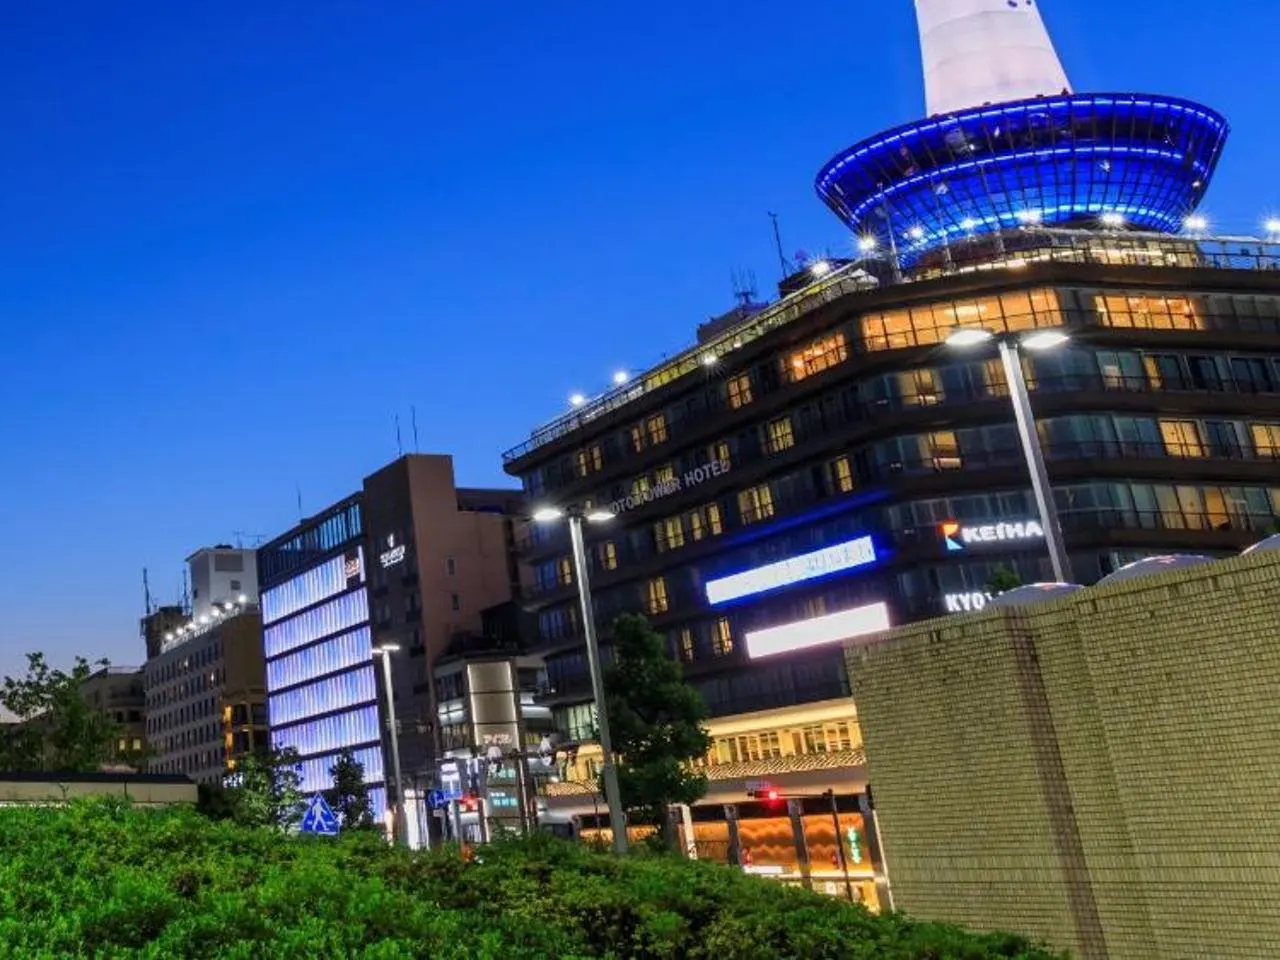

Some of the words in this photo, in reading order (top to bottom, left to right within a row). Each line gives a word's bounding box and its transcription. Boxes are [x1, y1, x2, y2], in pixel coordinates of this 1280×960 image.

[684, 458, 732, 487] HOTEL
[961, 520, 1044, 543] KEIHA
[944, 591, 1003, 612] KYO
